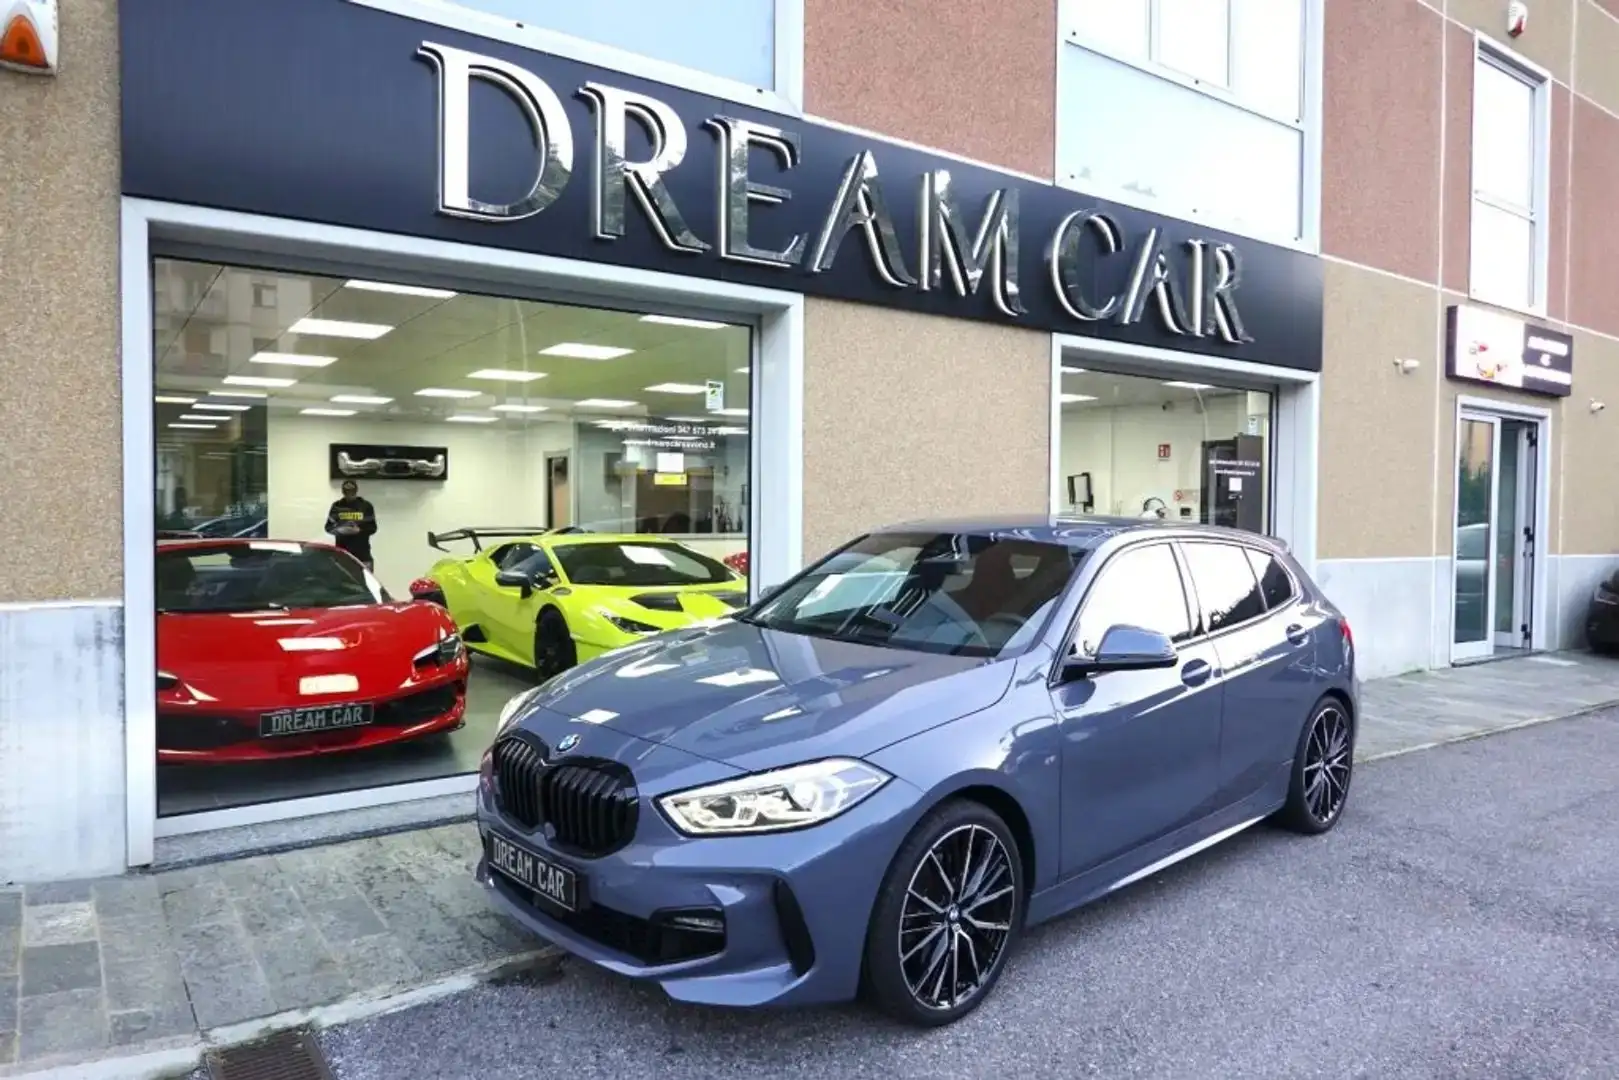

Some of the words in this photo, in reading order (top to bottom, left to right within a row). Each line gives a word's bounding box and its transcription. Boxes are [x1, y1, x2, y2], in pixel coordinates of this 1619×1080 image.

[416, 40, 1028, 317] DREAM
[1046, 208, 1255, 344] CAR
[271, 710, 326, 732] DREAM
[331, 706, 363, 725] CAR
[493, 836, 533, 884] DREAM
[537, 861, 566, 902] CAR
